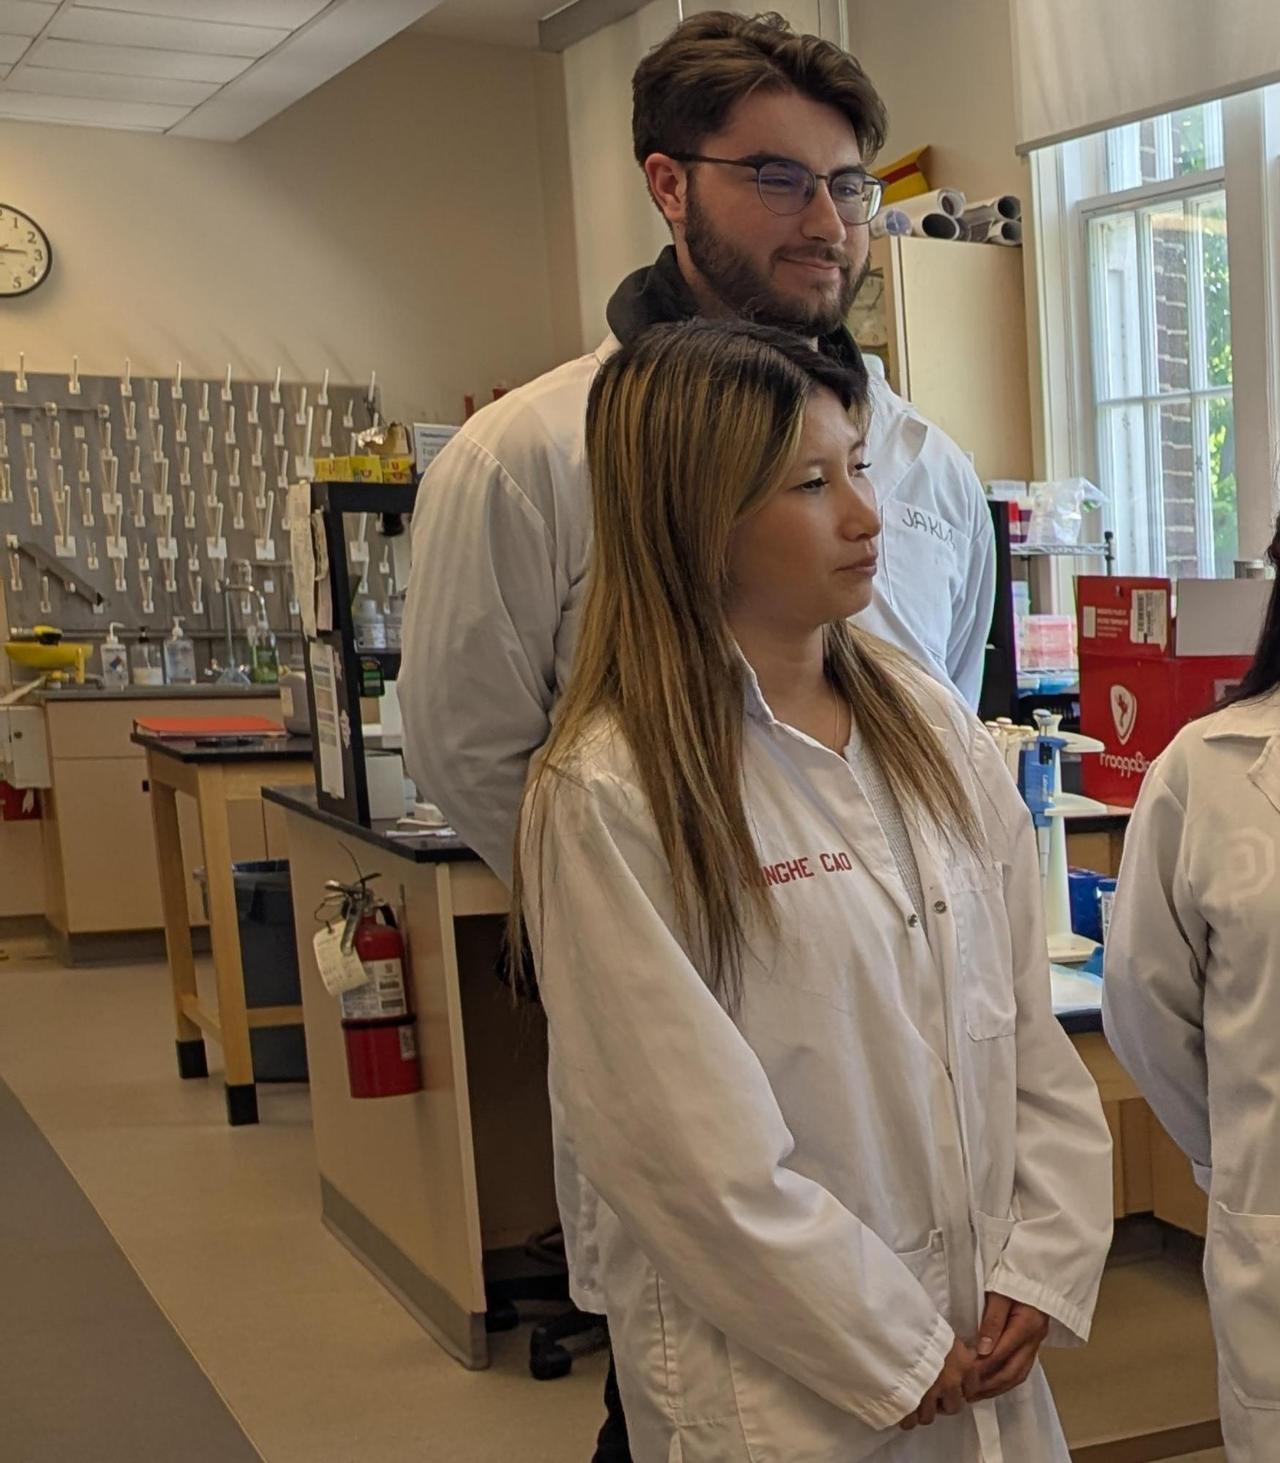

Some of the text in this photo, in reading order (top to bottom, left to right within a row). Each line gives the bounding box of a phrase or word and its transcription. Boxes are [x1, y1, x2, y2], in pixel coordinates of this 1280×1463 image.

[13, 216, 19, 229] 1
[27, 230, 36, 244] 2
[34, 248, 43, 262] 3
[28, 265, 36, 278] 4
[13, 276, 21, 289] 5
[819, 852, 852, 872] CAO
